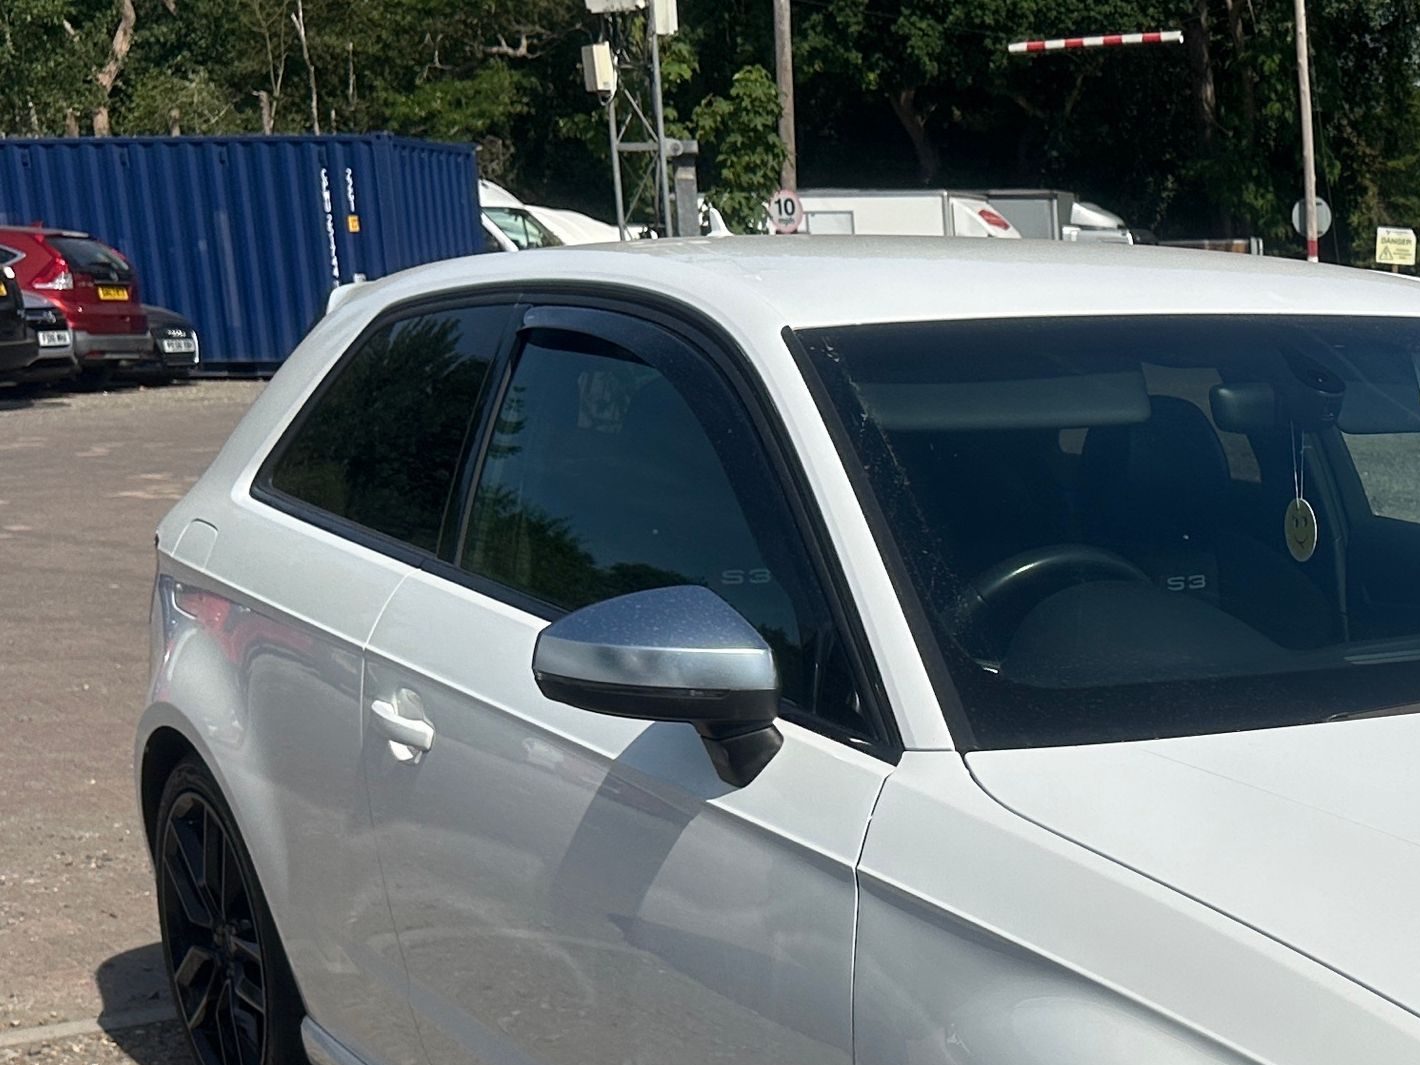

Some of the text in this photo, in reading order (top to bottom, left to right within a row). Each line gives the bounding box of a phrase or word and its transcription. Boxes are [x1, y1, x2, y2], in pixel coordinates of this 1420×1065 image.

[774, 198, 795, 216] 10
[1381, 236, 1412, 246] DANGER
[721, 568, 771, 584] S3
[1167, 574, 1206, 591] S3
